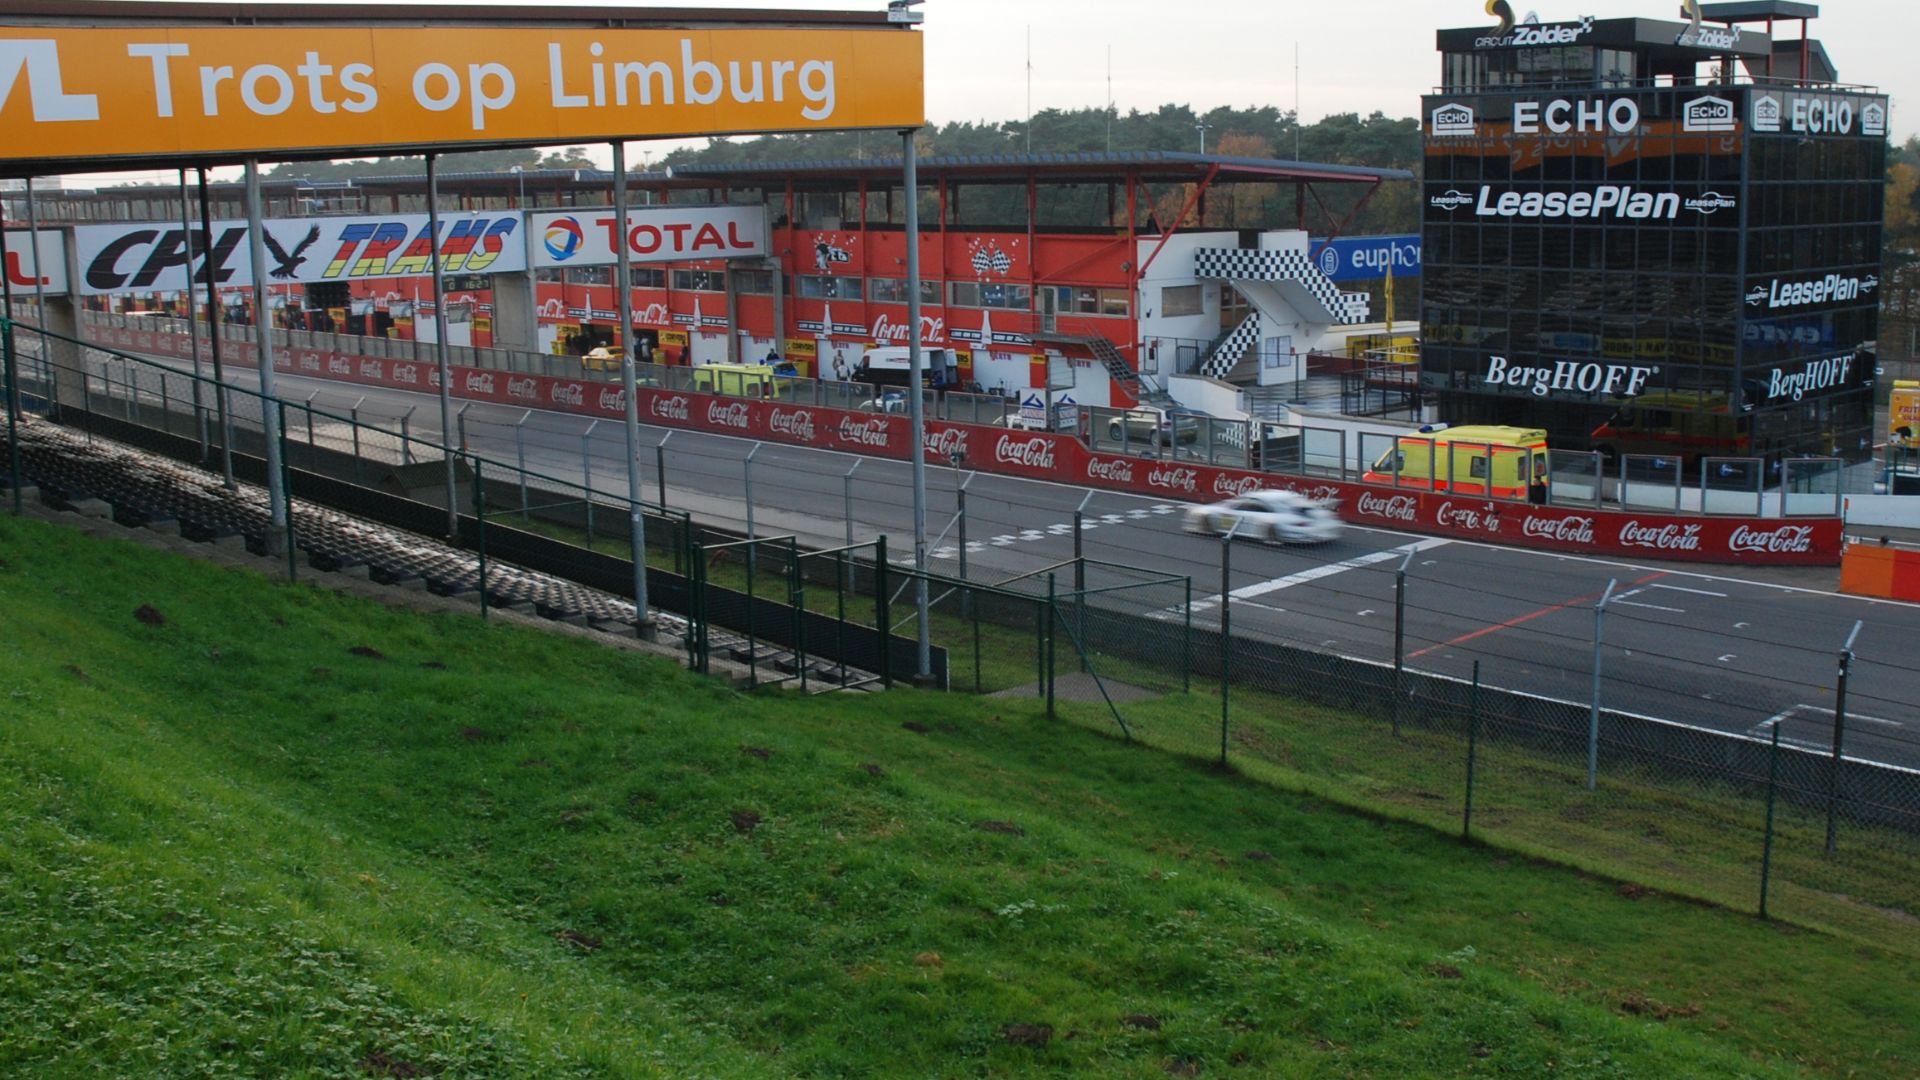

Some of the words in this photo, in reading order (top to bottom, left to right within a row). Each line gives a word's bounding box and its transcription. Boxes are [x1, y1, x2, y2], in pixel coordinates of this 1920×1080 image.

[1512, 25, 1582, 46] Zolder
[1697, 28, 1734, 48] Zolder
[127, 43, 378, 118] Trots
[412, 62, 516, 130] op
[548, 38, 836, 121] Limburg
[1438, 112, 1468, 123] ECHO
[1513, 97, 1639, 134] ECHO
[1689, 106, 1728, 119] ECHO
[1792, 98, 1851, 134] ECHO
[1431, 195, 1473, 204] LeasePlan
[1475, 185, 1680, 219] LeasePlan
[1685, 198, 1735, 208] LeasePlan
[596, 217, 754, 255] TOTAL
[86, 227, 248, 289] CPL
[322, 217, 518, 278] TRANS
[1769, 274, 1858, 308] LeasePlan
[707, 400, 749, 429] Coca-Cola
[996, 434, 1057, 469] Coca-Cola
[1087, 457, 1133, 483] Coca-Cola
[1358, 491, 1417, 521] Coca-Cola
[1523, 515, 1596, 543] Coca-Cola
[1618, 520, 1702, 550] Coca-Cola
[1728, 525, 1814, 552] Coca-Cola
